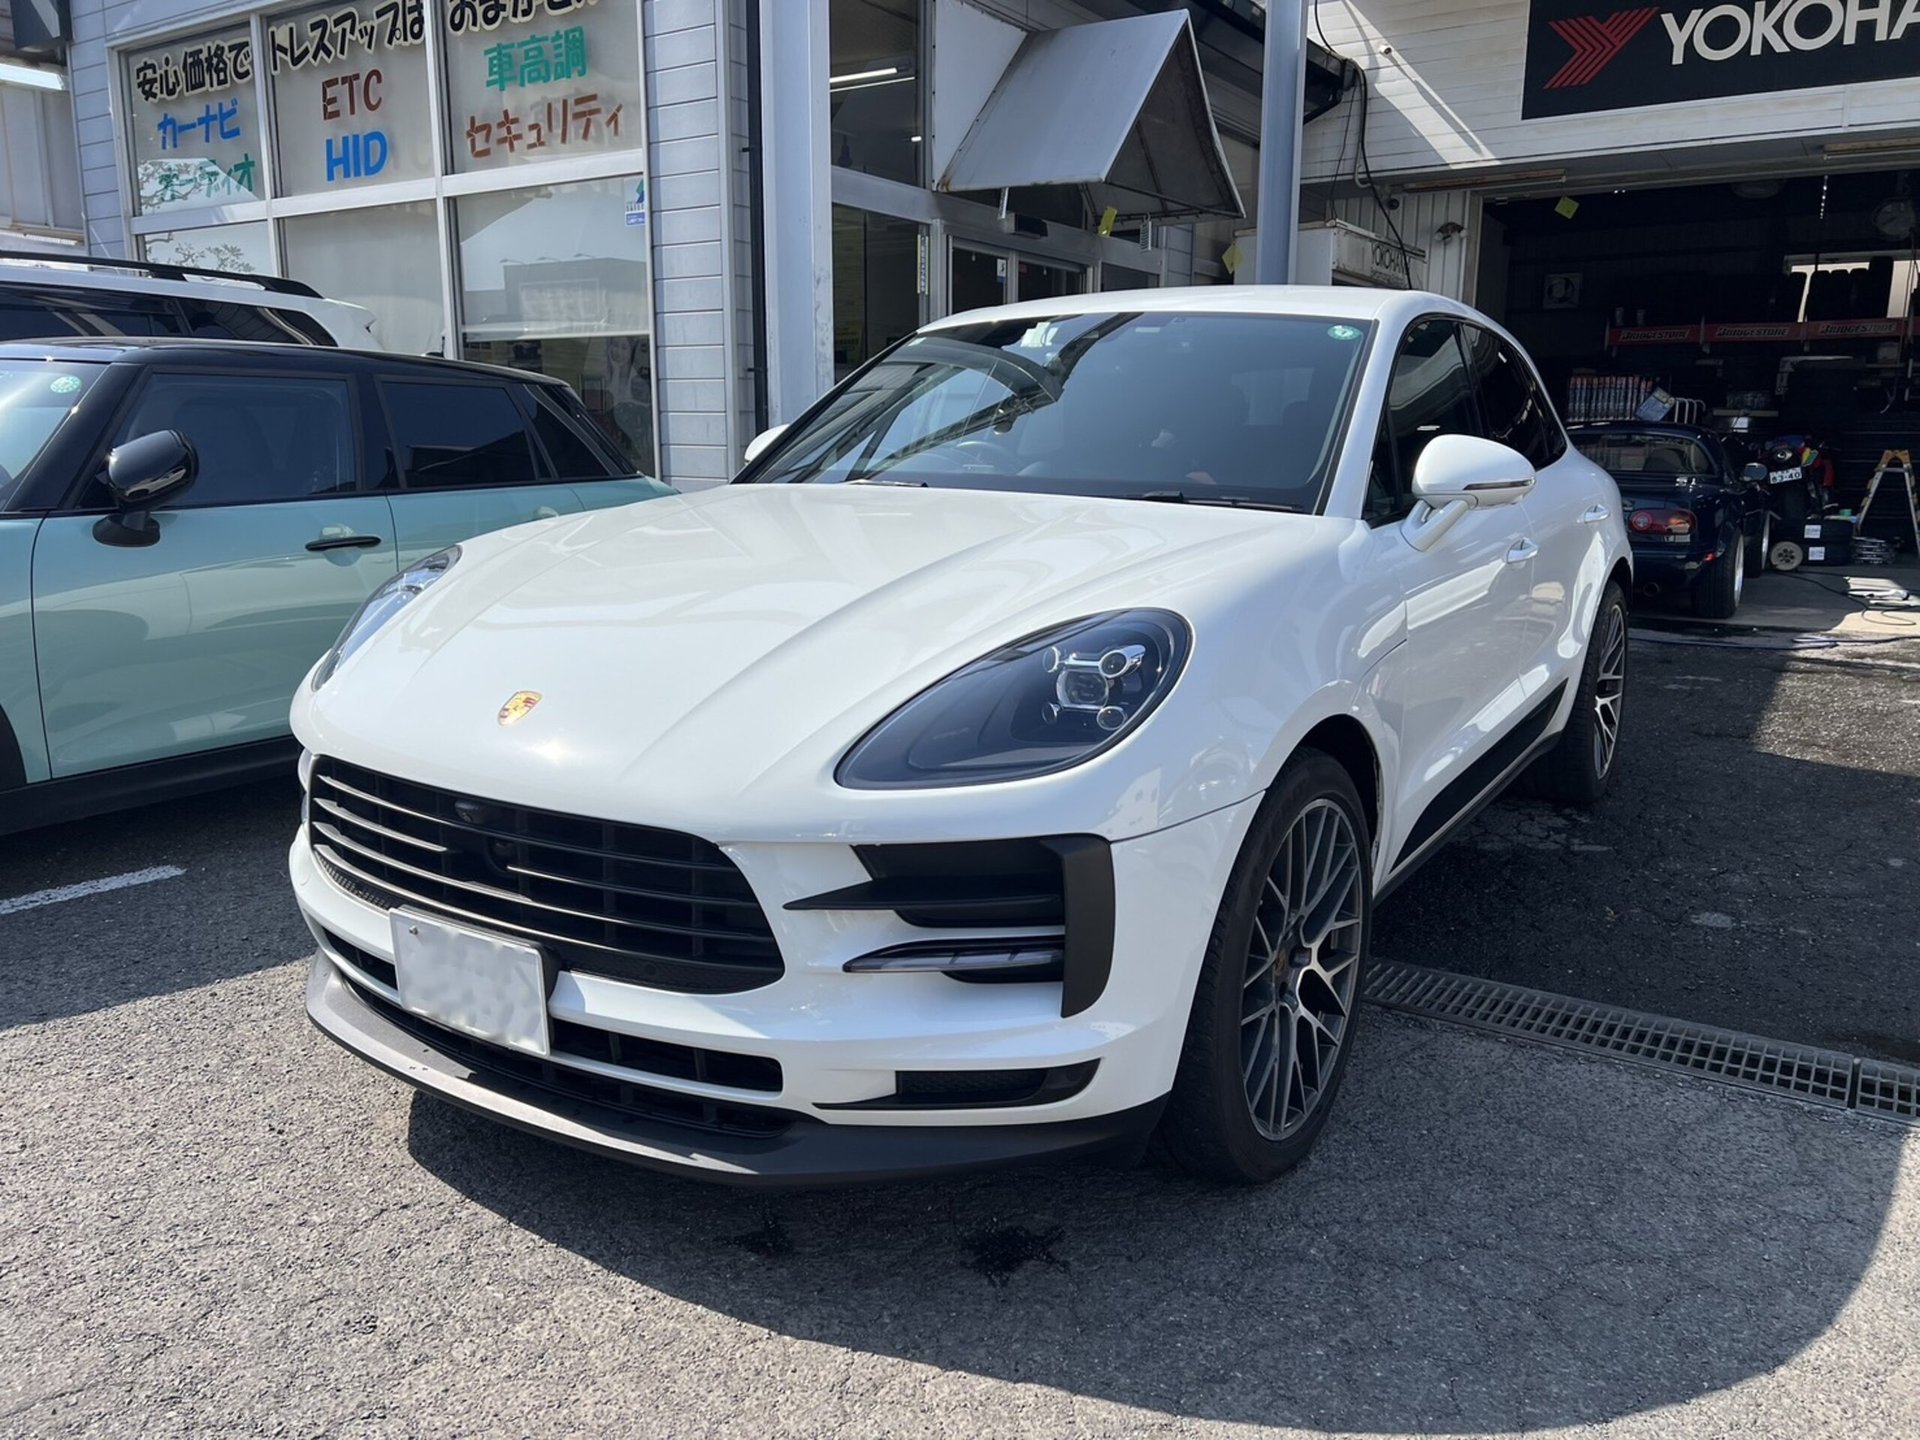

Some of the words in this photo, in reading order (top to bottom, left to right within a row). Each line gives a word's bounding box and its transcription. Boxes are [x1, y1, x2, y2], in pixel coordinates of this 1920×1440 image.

[135, 41, 251, 101] 安心価格で
[483, 25, 588, 92] 車高調
[321, 68, 383, 121] ETC
[157, 98, 241, 150] カーナビ
[465, 93, 624, 158] セキュリティ
[325, 130, 388, 182] HID
